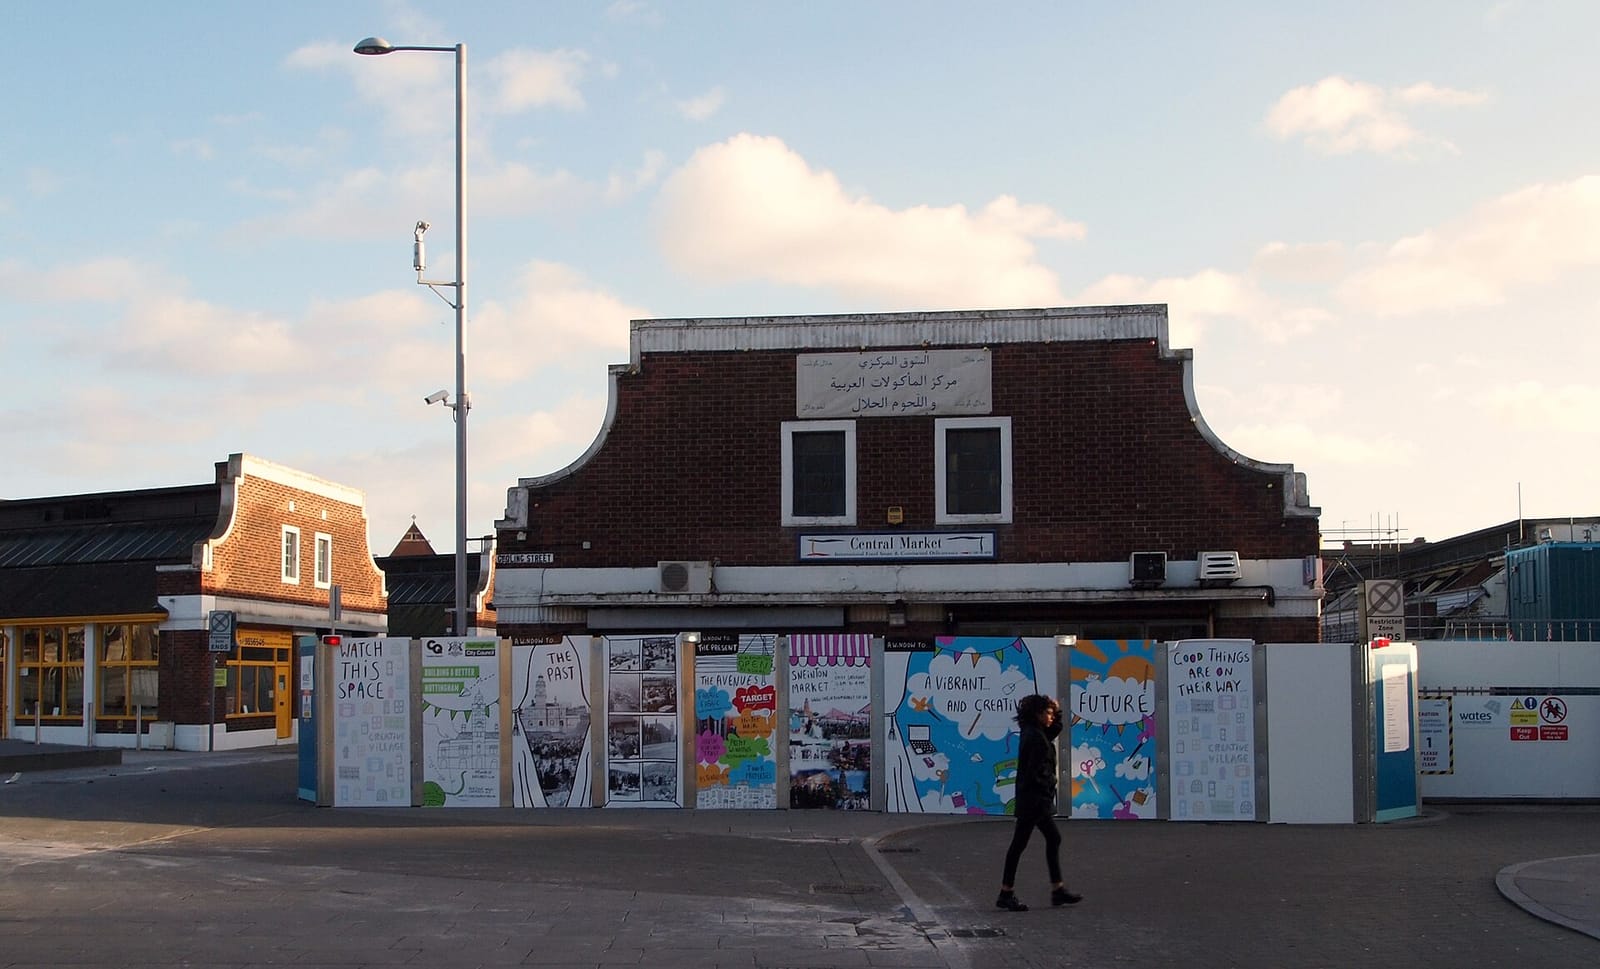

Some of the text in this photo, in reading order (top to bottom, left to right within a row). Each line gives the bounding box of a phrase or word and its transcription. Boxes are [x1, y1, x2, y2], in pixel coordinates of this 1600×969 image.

[850, 536, 941, 550] Central Market
[526, 554, 551, 562] STREET
[340, 641, 382, 658] WATCH
[697, 643, 738, 652] THE PRESENT
[887, 641, 892, 649] A
[546, 650, 573, 664] THE
[547, 666, 574, 682] PAST
[1188, 667, 1232, 679] ARE ON
[700, 675, 759, 687] THE AVENUES
[924, 676, 932, 690] A
[338, 682, 385, 699] SPACE
[791, 681, 829, 694] MARKET
[740, 693, 773, 703] TARGET
[1079, 691, 1148, 713] FUTURE
[946, 700, 967, 712] AND
[1459, 711, 1492, 721] wates
[1426, 737, 1431, 748] 1
